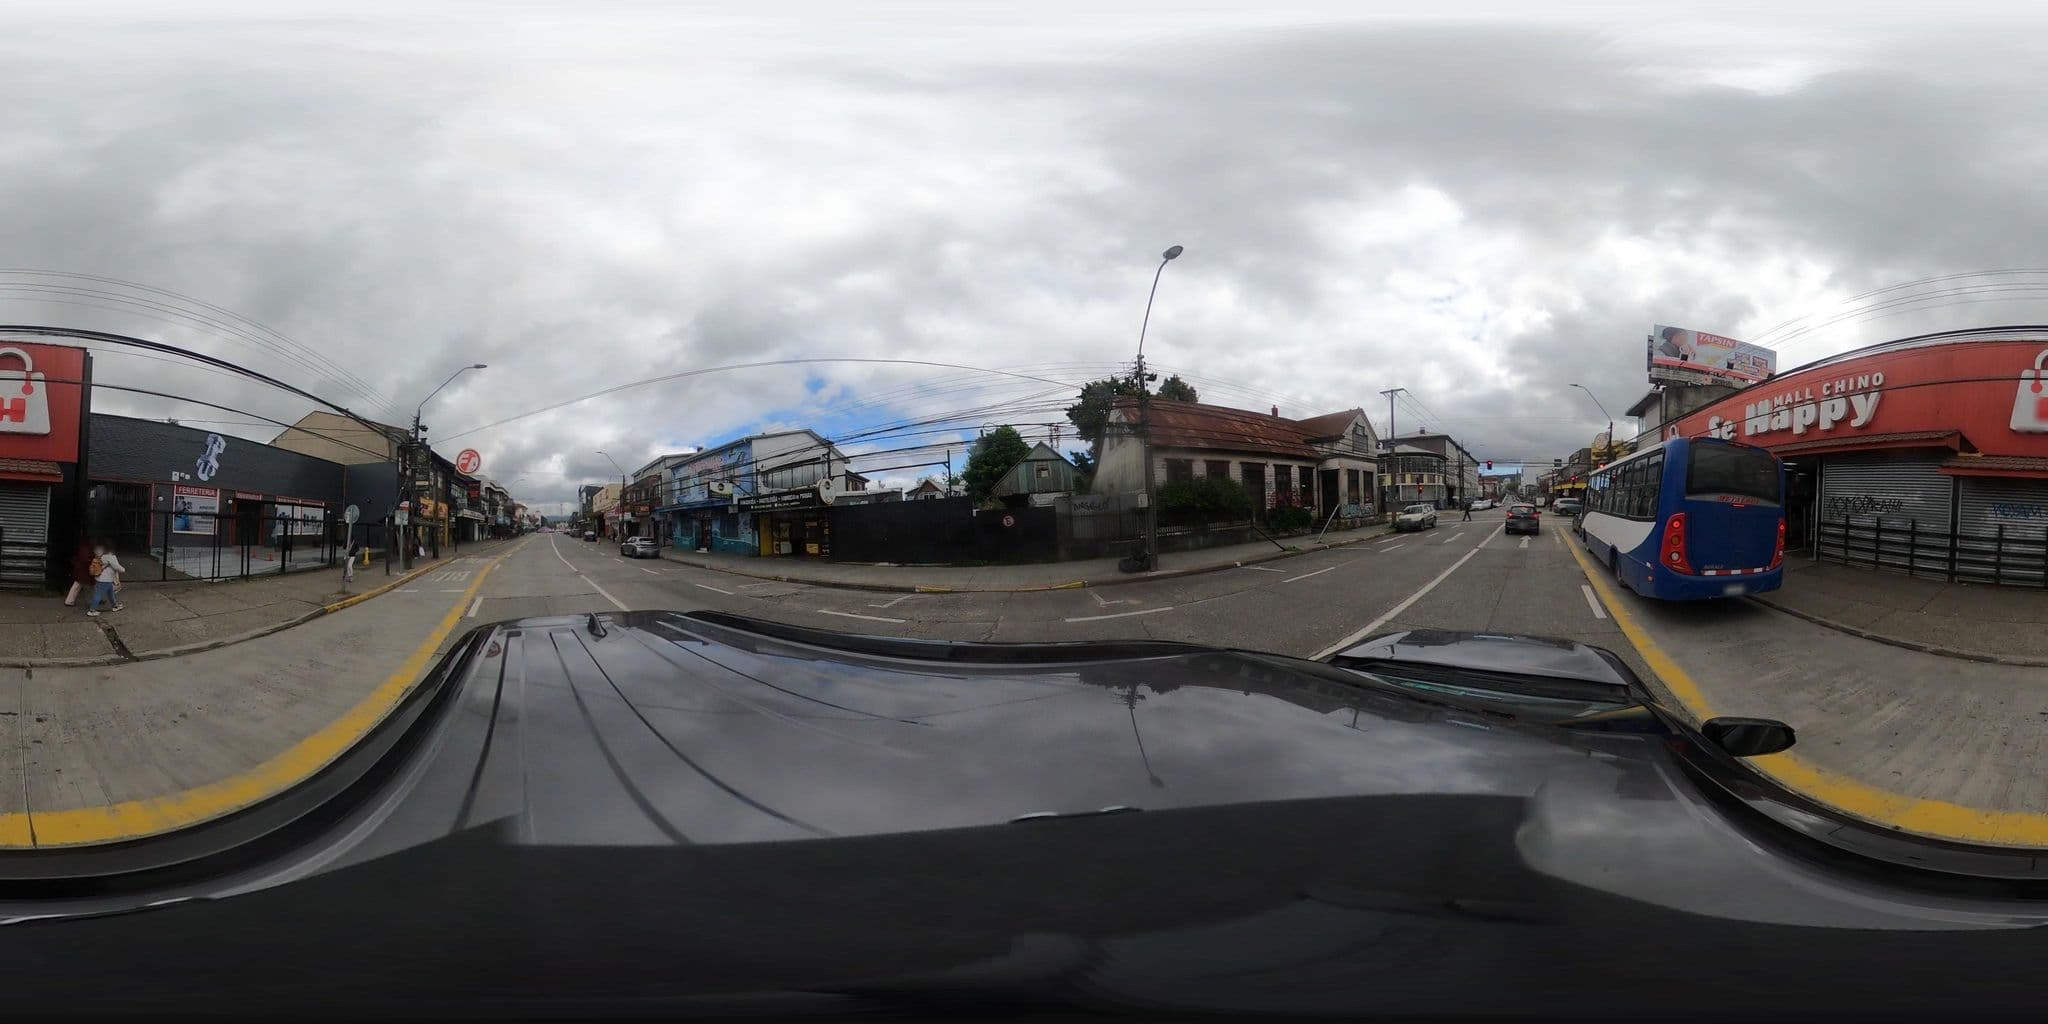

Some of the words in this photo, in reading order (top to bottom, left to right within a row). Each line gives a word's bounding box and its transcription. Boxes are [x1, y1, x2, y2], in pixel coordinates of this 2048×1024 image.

[1698, 333, 1735, 347] TAPSIN
[1773, 388, 1814, 407] MALL
[1823, 372, 1885, 396] CHINO
[1745, 391, 1881, 436] Happy
